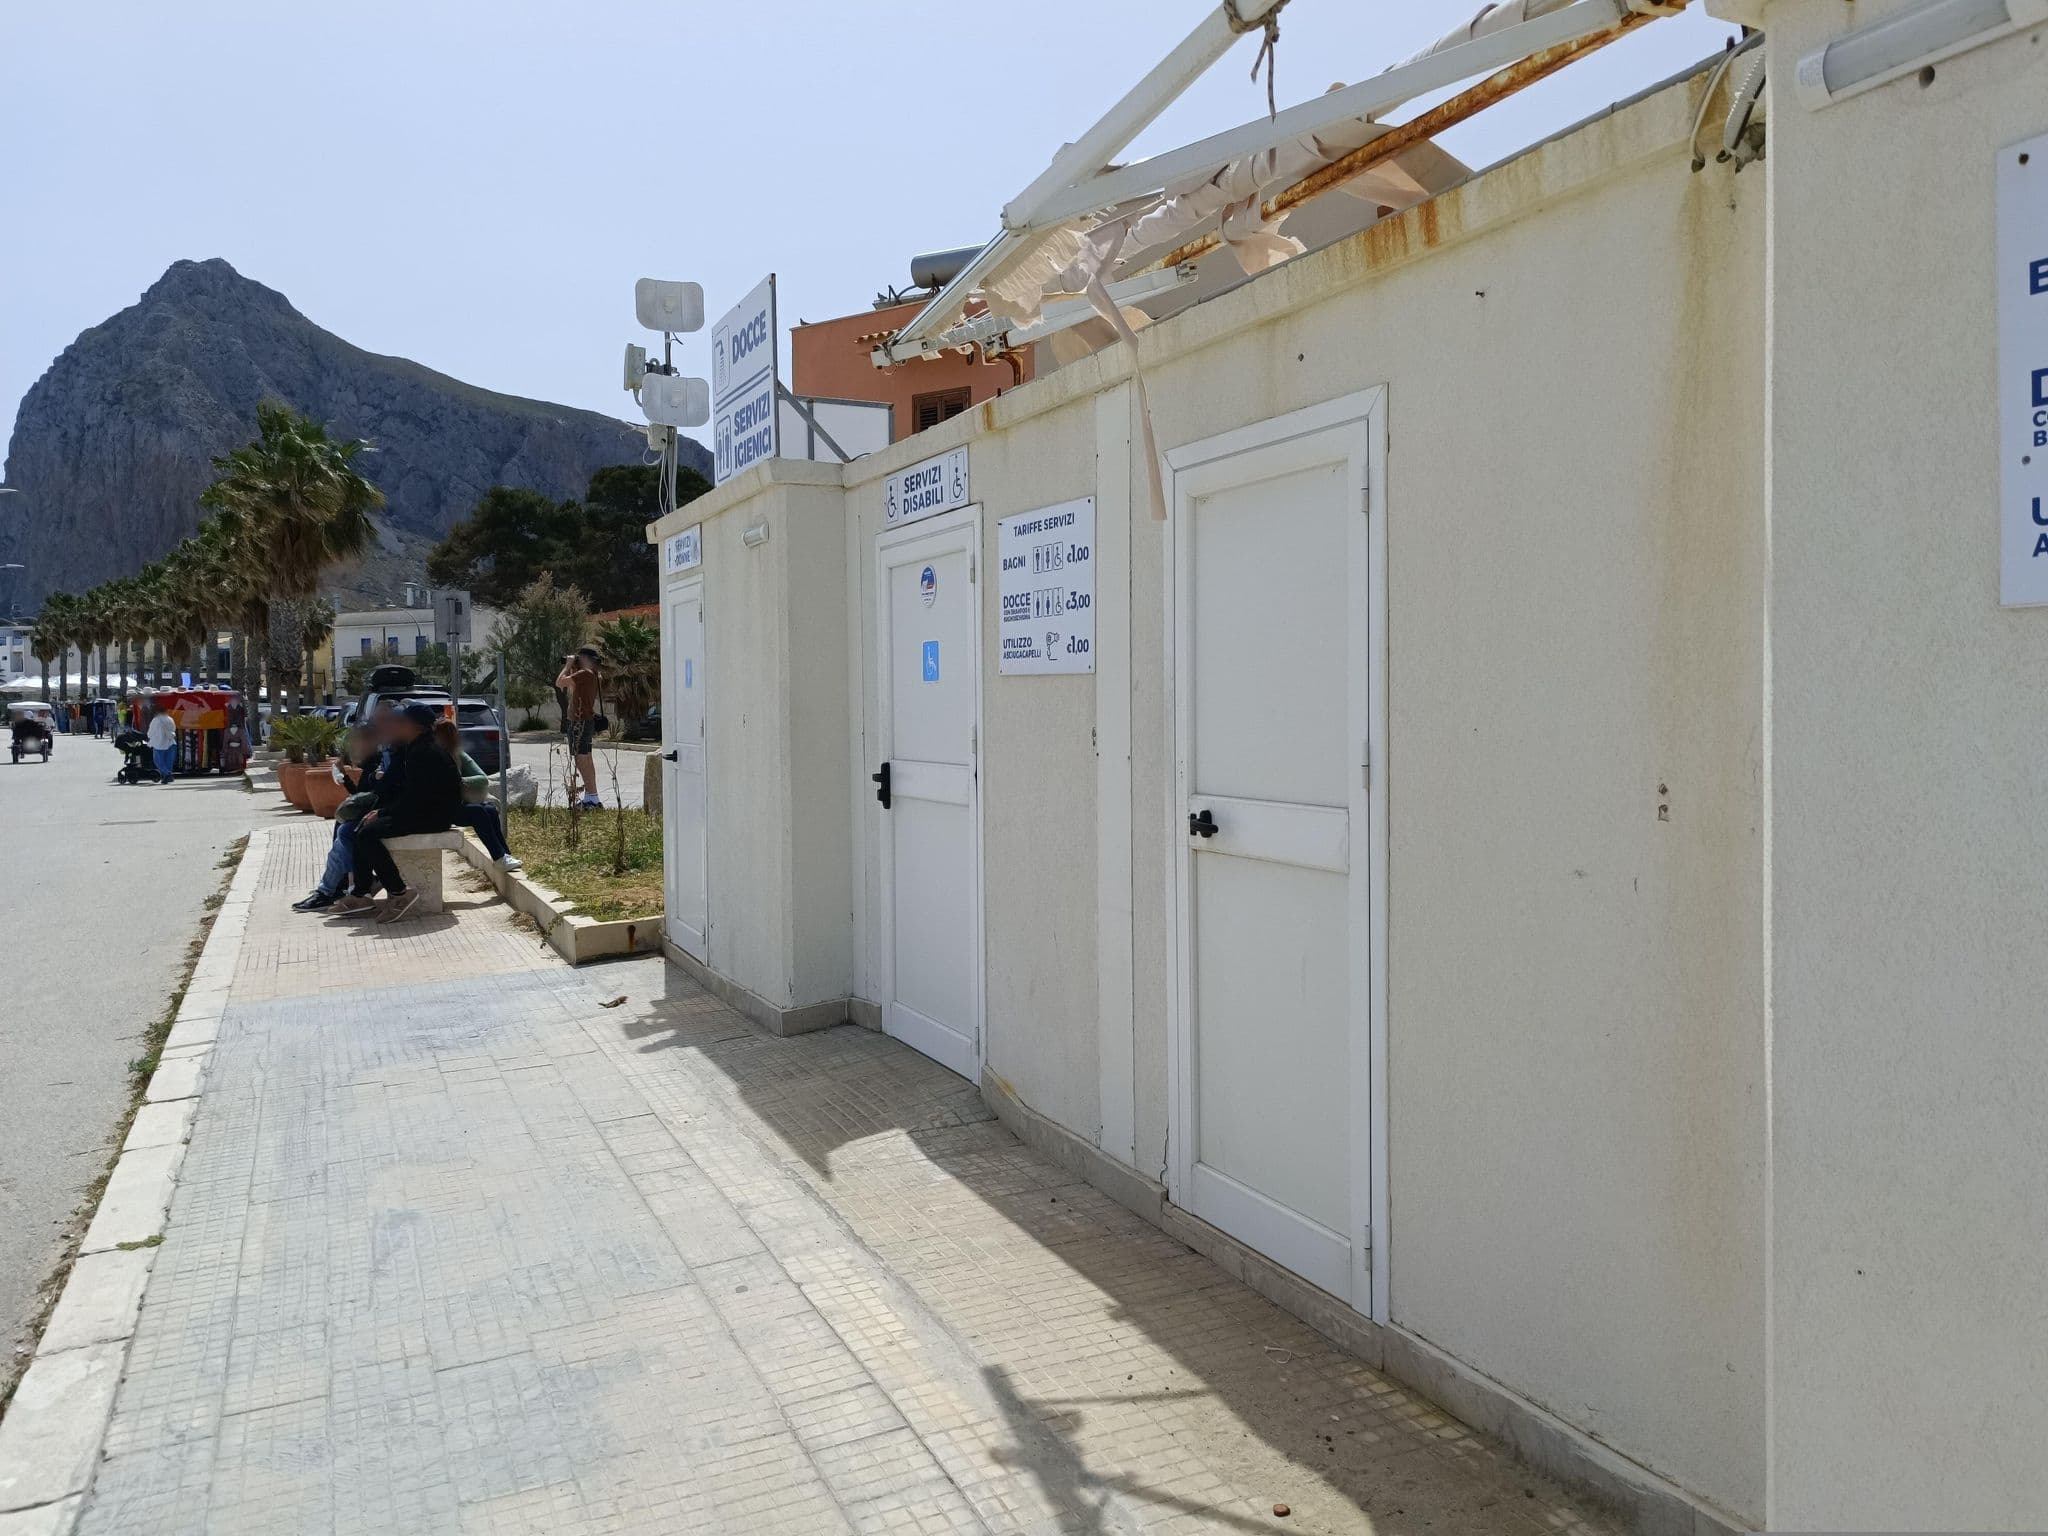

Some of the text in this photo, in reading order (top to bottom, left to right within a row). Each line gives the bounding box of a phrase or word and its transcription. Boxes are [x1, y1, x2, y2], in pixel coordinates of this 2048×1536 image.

[732, 309, 767, 366] DOCCE
[734, 390, 771, 437] SERVIZI
[734, 425, 772, 469] IGIENICI
[903, 464, 942, 495] SERVIZI
[903, 485, 944, 515] DISABILI
[1014, 512, 1075, 537] TARIFFE SERVIZI
[1003, 555, 1026, 571] BAGNI
[1003, 592, 1031, 609] DOCCE
[1003, 637, 1033, 649] UTILIZZO
